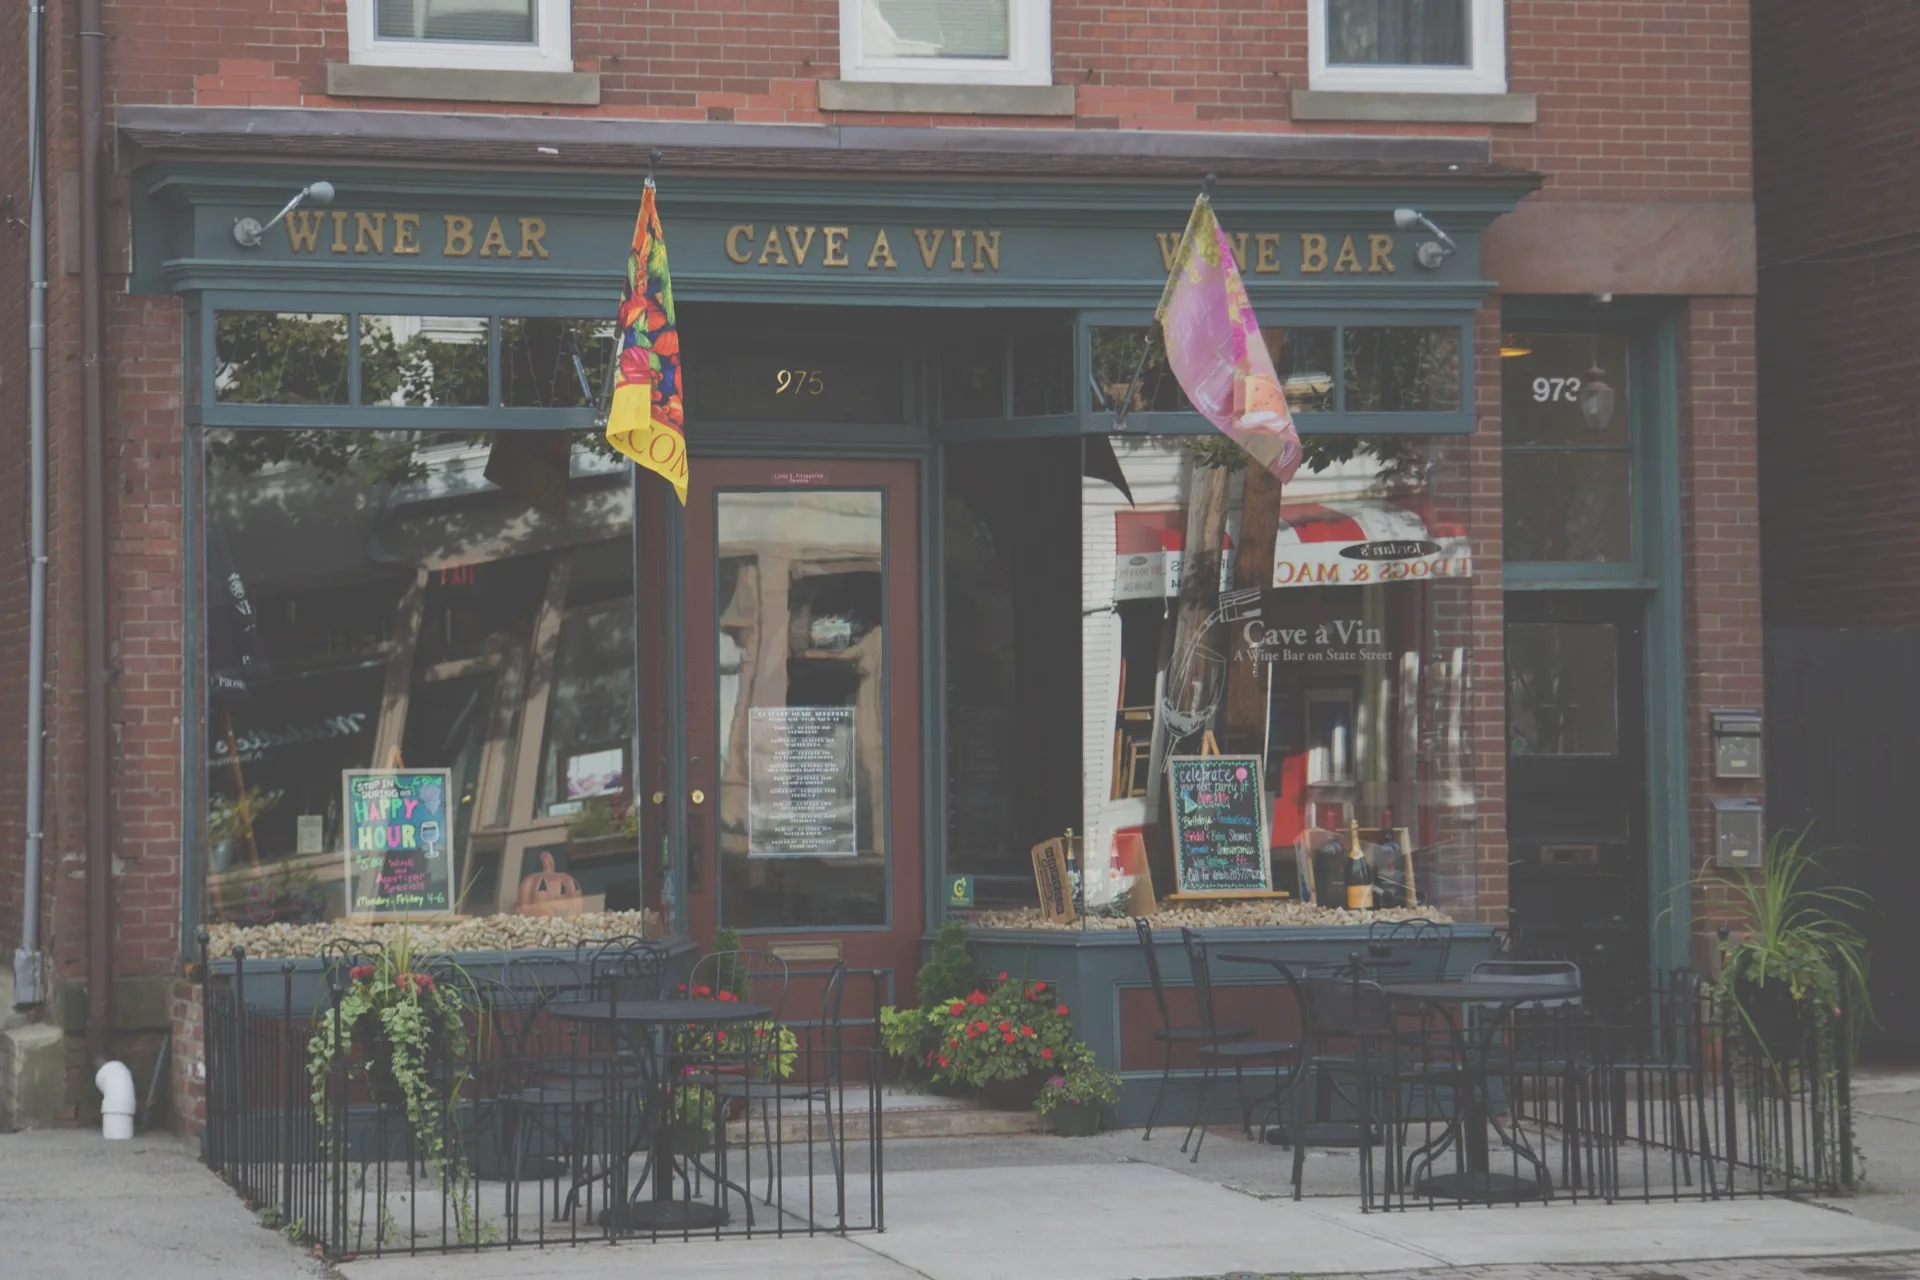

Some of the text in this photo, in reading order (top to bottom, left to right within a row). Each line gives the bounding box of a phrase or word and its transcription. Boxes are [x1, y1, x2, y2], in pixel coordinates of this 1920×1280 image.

[285, 211, 549, 259] WINE BAR
[724, 224, 1002, 272] CAVE A VIN
[1156, 233, 1396, 273] WNE BAR
[776, 369, 824, 394] 975
[1532, 377, 1581, 402] 973
[1243, 620, 1383, 647] Cave à Vin
[1234, 648, 1393, 661] A Wine Bar on State Street
[356, 779, 394, 792] STOP IN
[1179, 765, 1235, 783] celebrate
[361, 789, 399, 800] DURING
[1214, 782, 1239, 799] party
[354, 798, 418, 824] HAPPY
[358, 824, 417, 850] HOUR
[376, 872, 425, 883] Appetizer
